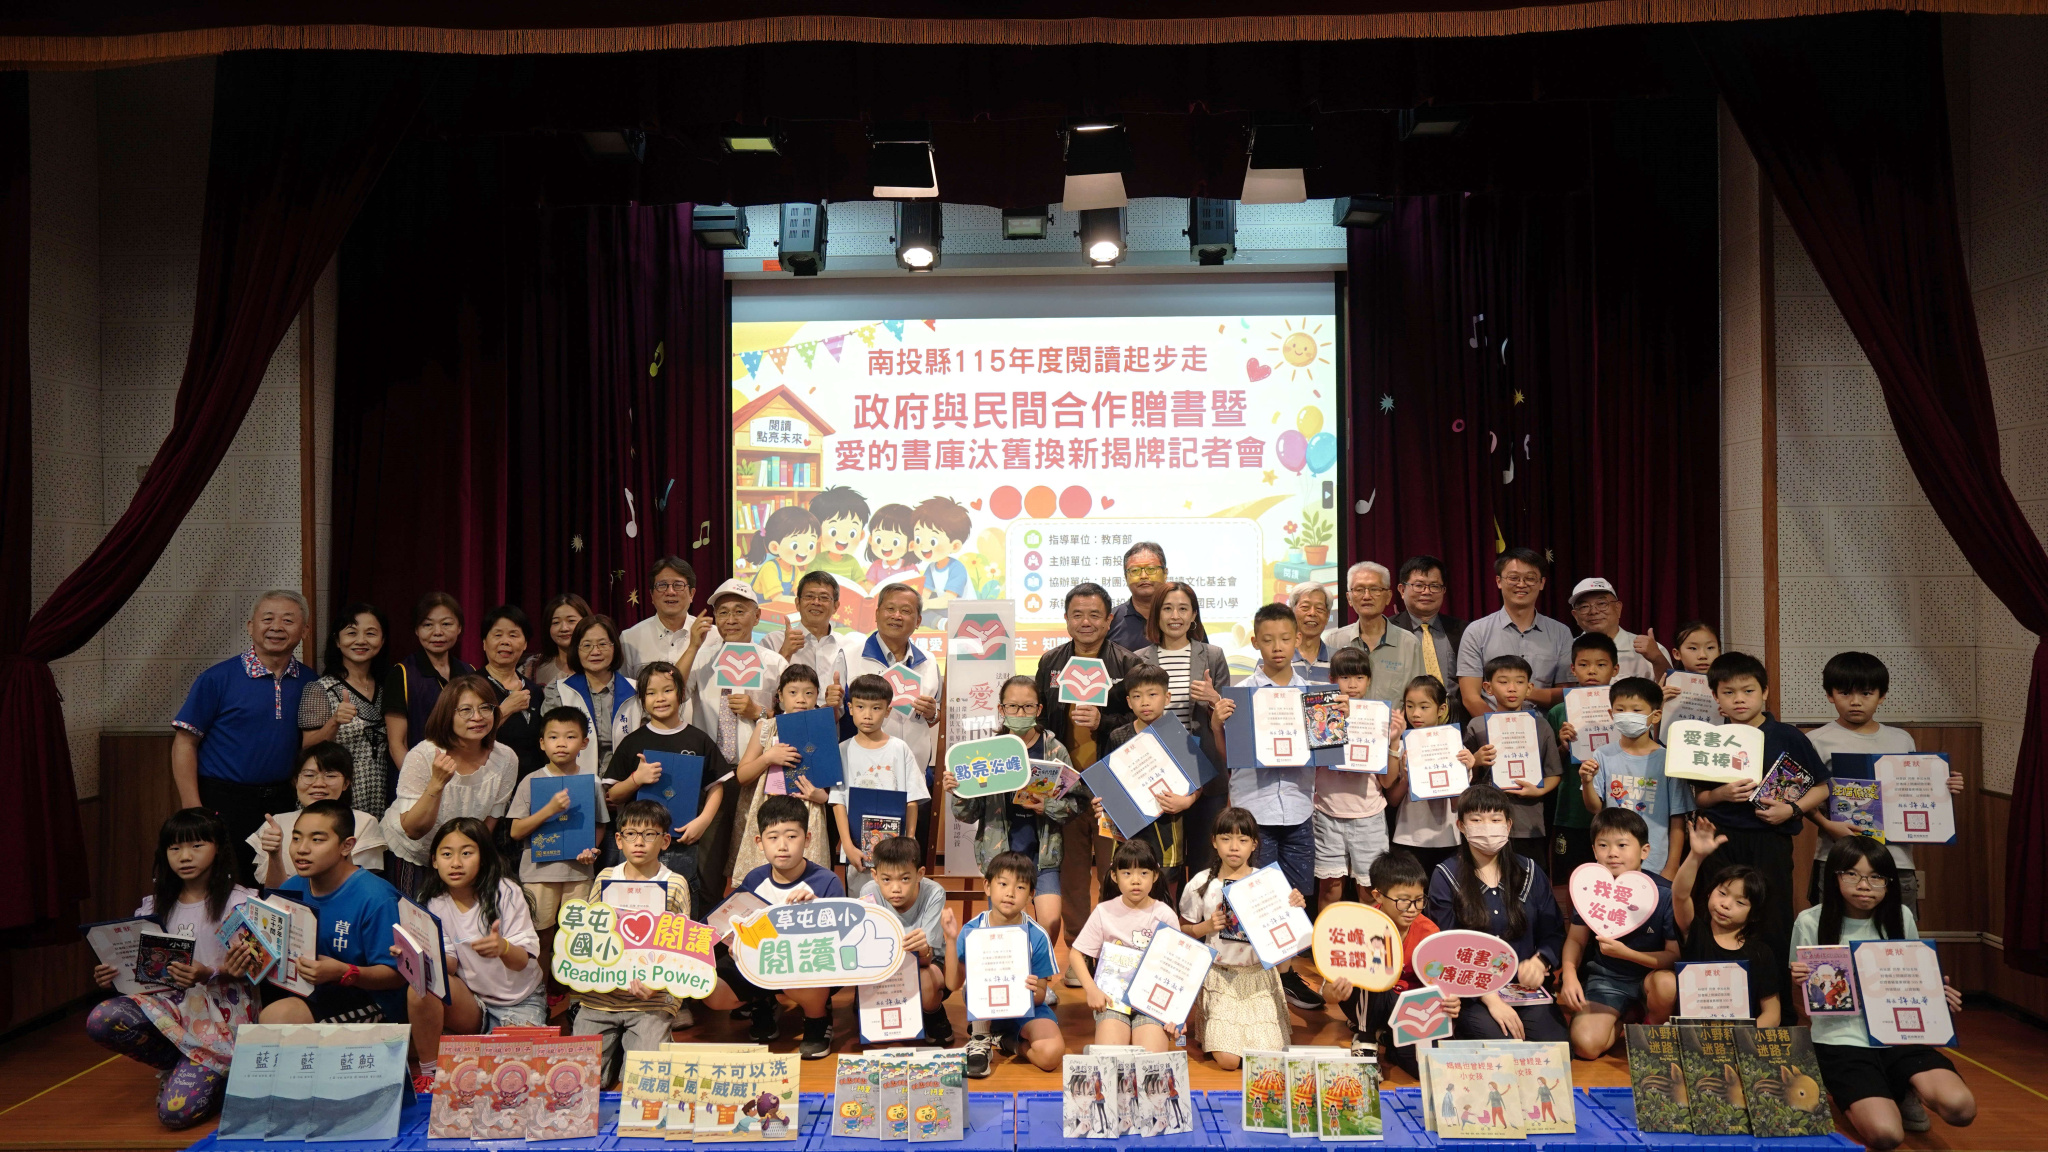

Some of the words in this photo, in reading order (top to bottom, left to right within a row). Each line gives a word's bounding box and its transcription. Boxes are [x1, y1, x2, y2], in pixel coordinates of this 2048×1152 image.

[867, 345, 1208, 377] 南投縣115年度閱讀起步走
[853, 389, 1248, 431] 政府與民間合作贈書暨
[769, 419, 791, 431] 閱讀
[756, 431, 802, 444] 點亮未來
[834, 435, 1267, 472] 愛的書庫汰舊換新揭牌記者會
[1049, 534, 1133, 545] 指導單位：教育部
[1283, 567, 1299, 579] 閱讀
[1683, 730, 1742, 749] 愛書人
[1692, 750, 1730, 768] 真棒
[1593, 879, 1633, 905] 我愛
[561, 904, 611, 934] 草屯
[775, 907, 858, 930] 草屯國小
[333, 920, 351, 952] 草中
[653, 913, 718, 956] 閱讀
[569, 932, 619, 961] 國小
[759, 936, 837, 975] 閱讀
[1330, 949, 1366, 969] 最讚
[1455, 947, 1492, 968] 擁書
[557, 959, 626, 986] Reading
[632, 965, 647, 982] is
[652, 965, 710, 993] Power.
[1438, 966, 1493, 991] 傳遞愛
[1755, 1029, 1791, 1042] 小野豬
[1649, 1041, 1678, 1054] 迷路
[1757, 1043, 1792, 1057] 迷路了
[301, 1052, 315, 1070] 藍
[340, 1052, 375, 1071] 藍鯨
[639, 1061, 671, 1076] 不可
[711, 1060, 788, 1079] 不可以洗
[1446, 1061, 1494, 1070] 媽媽也曾經是
[1460, 1072, 1484, 1081] 小女孩
[1515, 1068, 1533, 1076] 女孩
